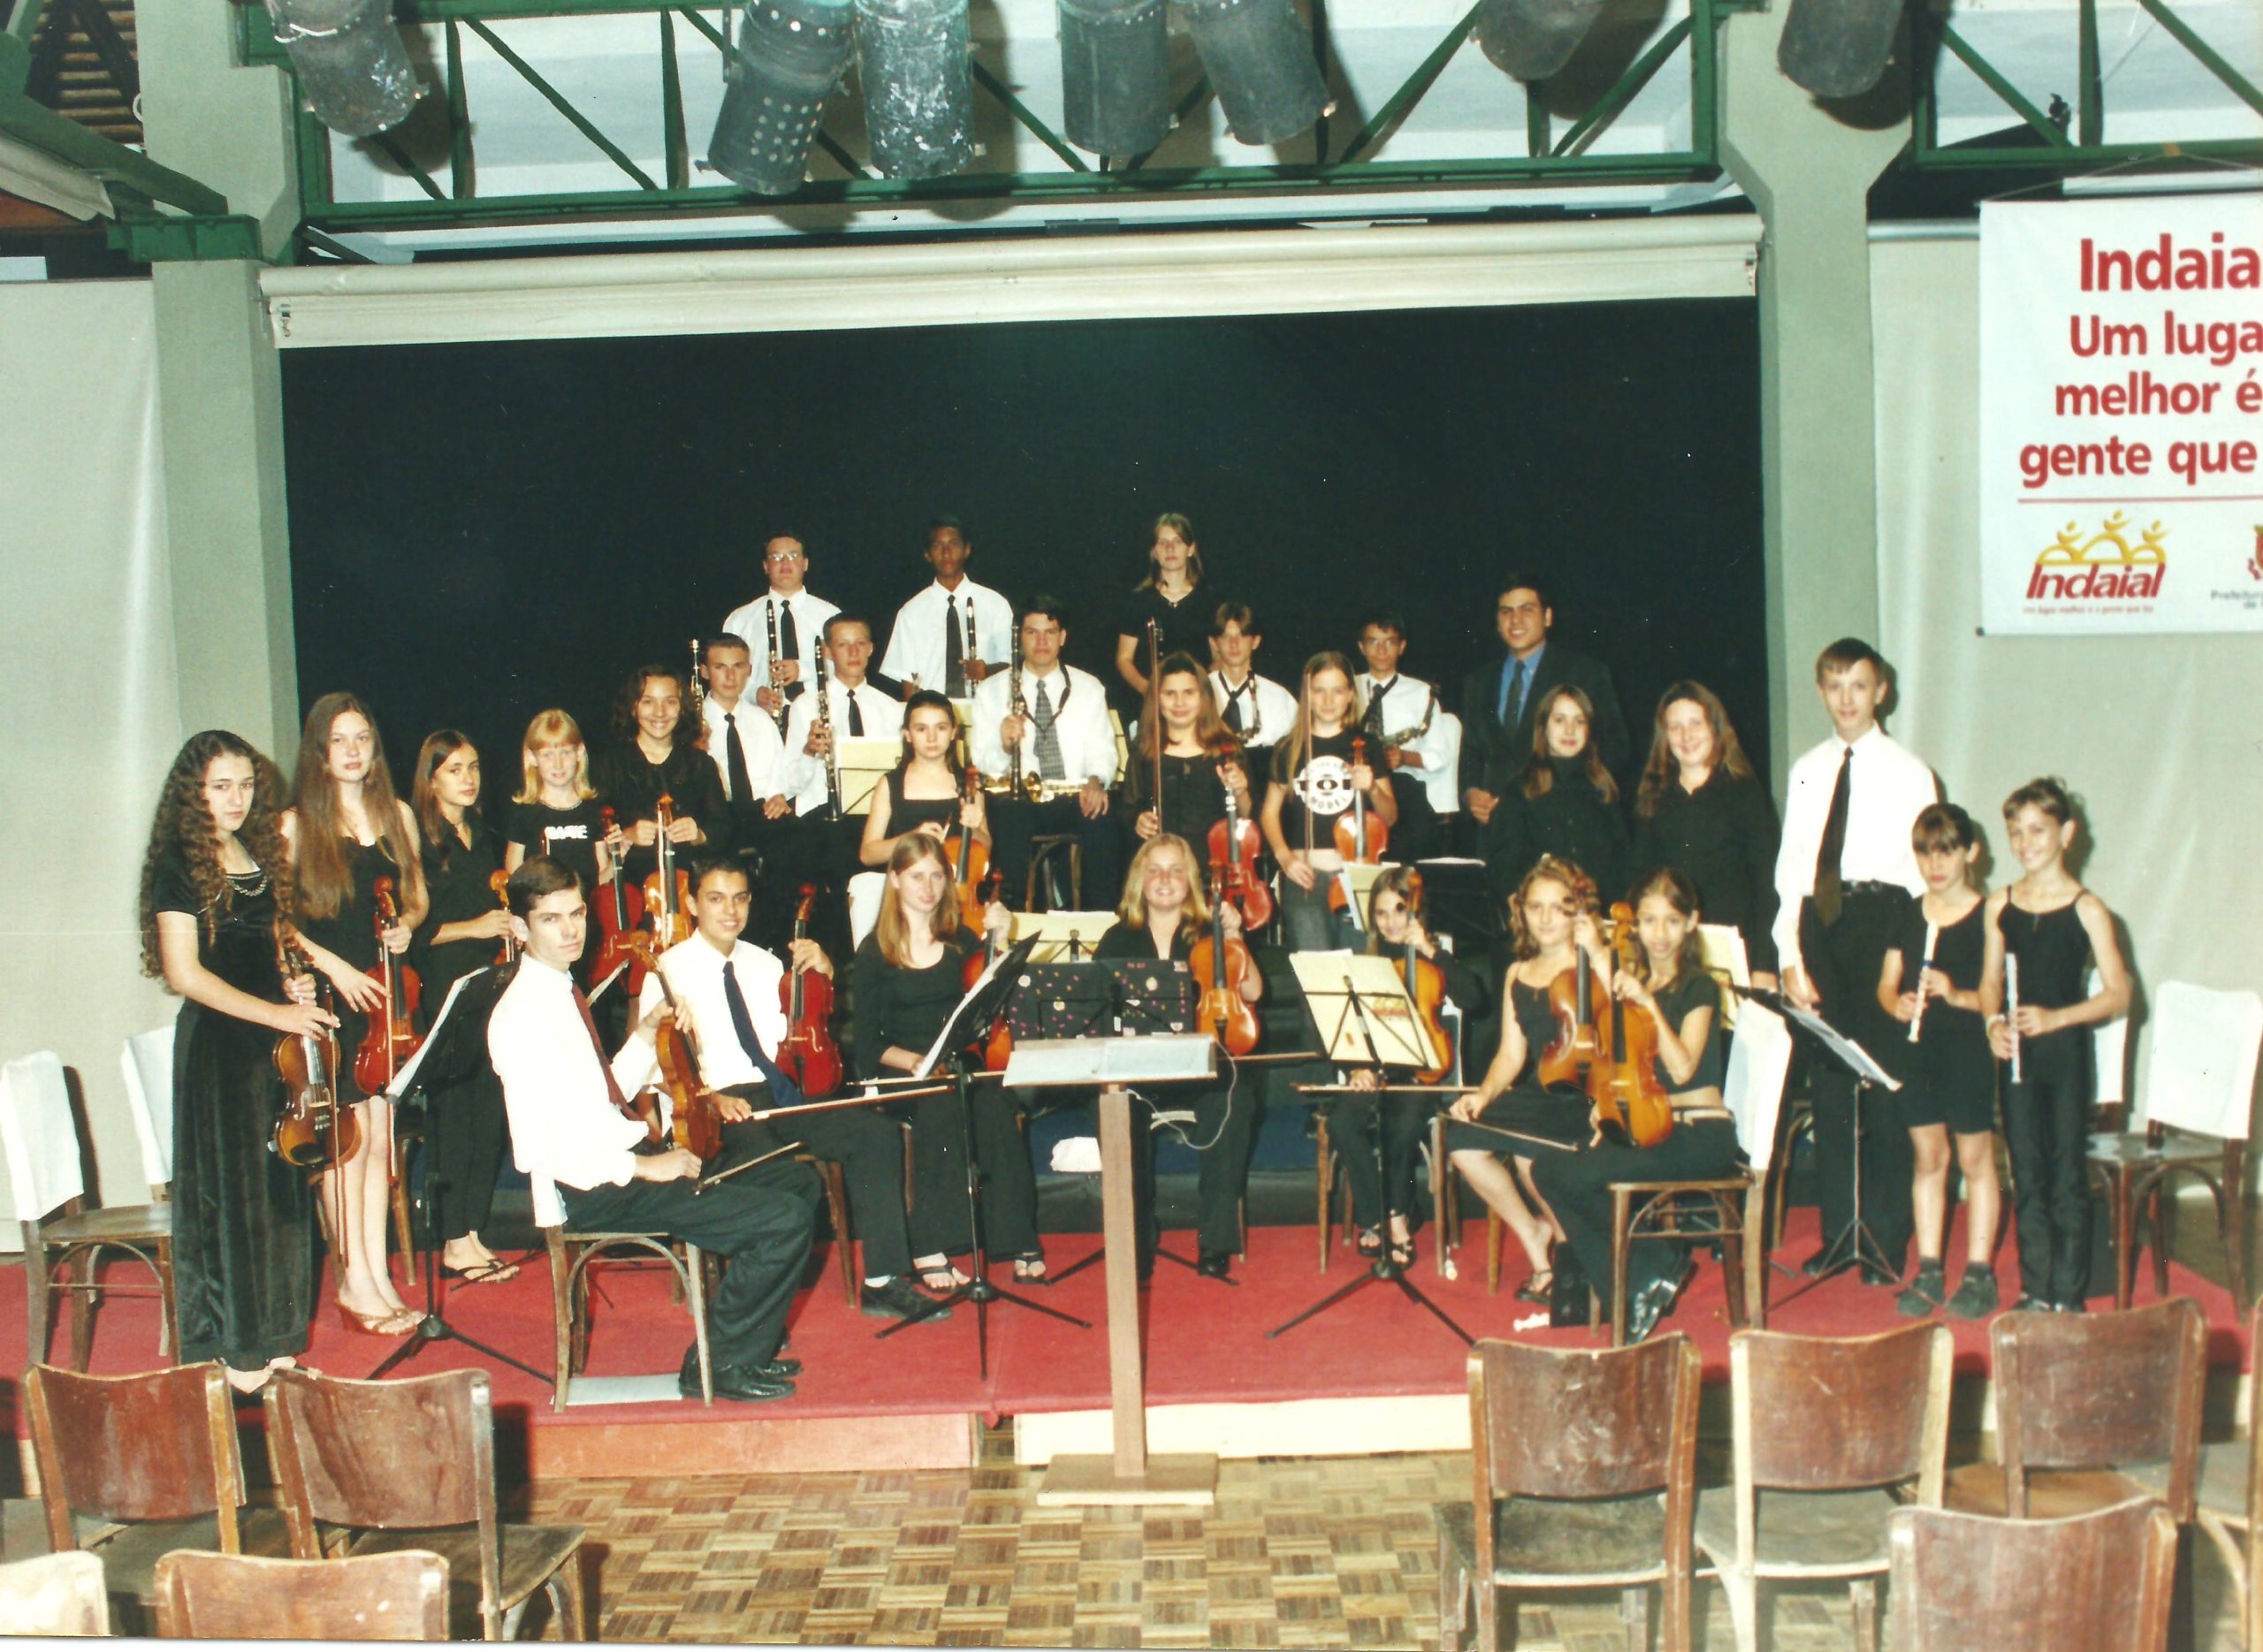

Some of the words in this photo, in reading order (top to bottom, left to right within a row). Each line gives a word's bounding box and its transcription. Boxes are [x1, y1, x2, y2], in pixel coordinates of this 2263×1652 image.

[2079, 232, 2262, 293] Indaia
[2069, 314, 2148, 358] Um
[2163, 310, 2263, 367] luga
[2054, 370, 2222, 417] melhor
[2235, 367, 2263, 414] é
[2019, 435, 2153, 490] gente
[2167, 441, 2259, 487] que
[2025, 561, 2167, 599] Indaial
